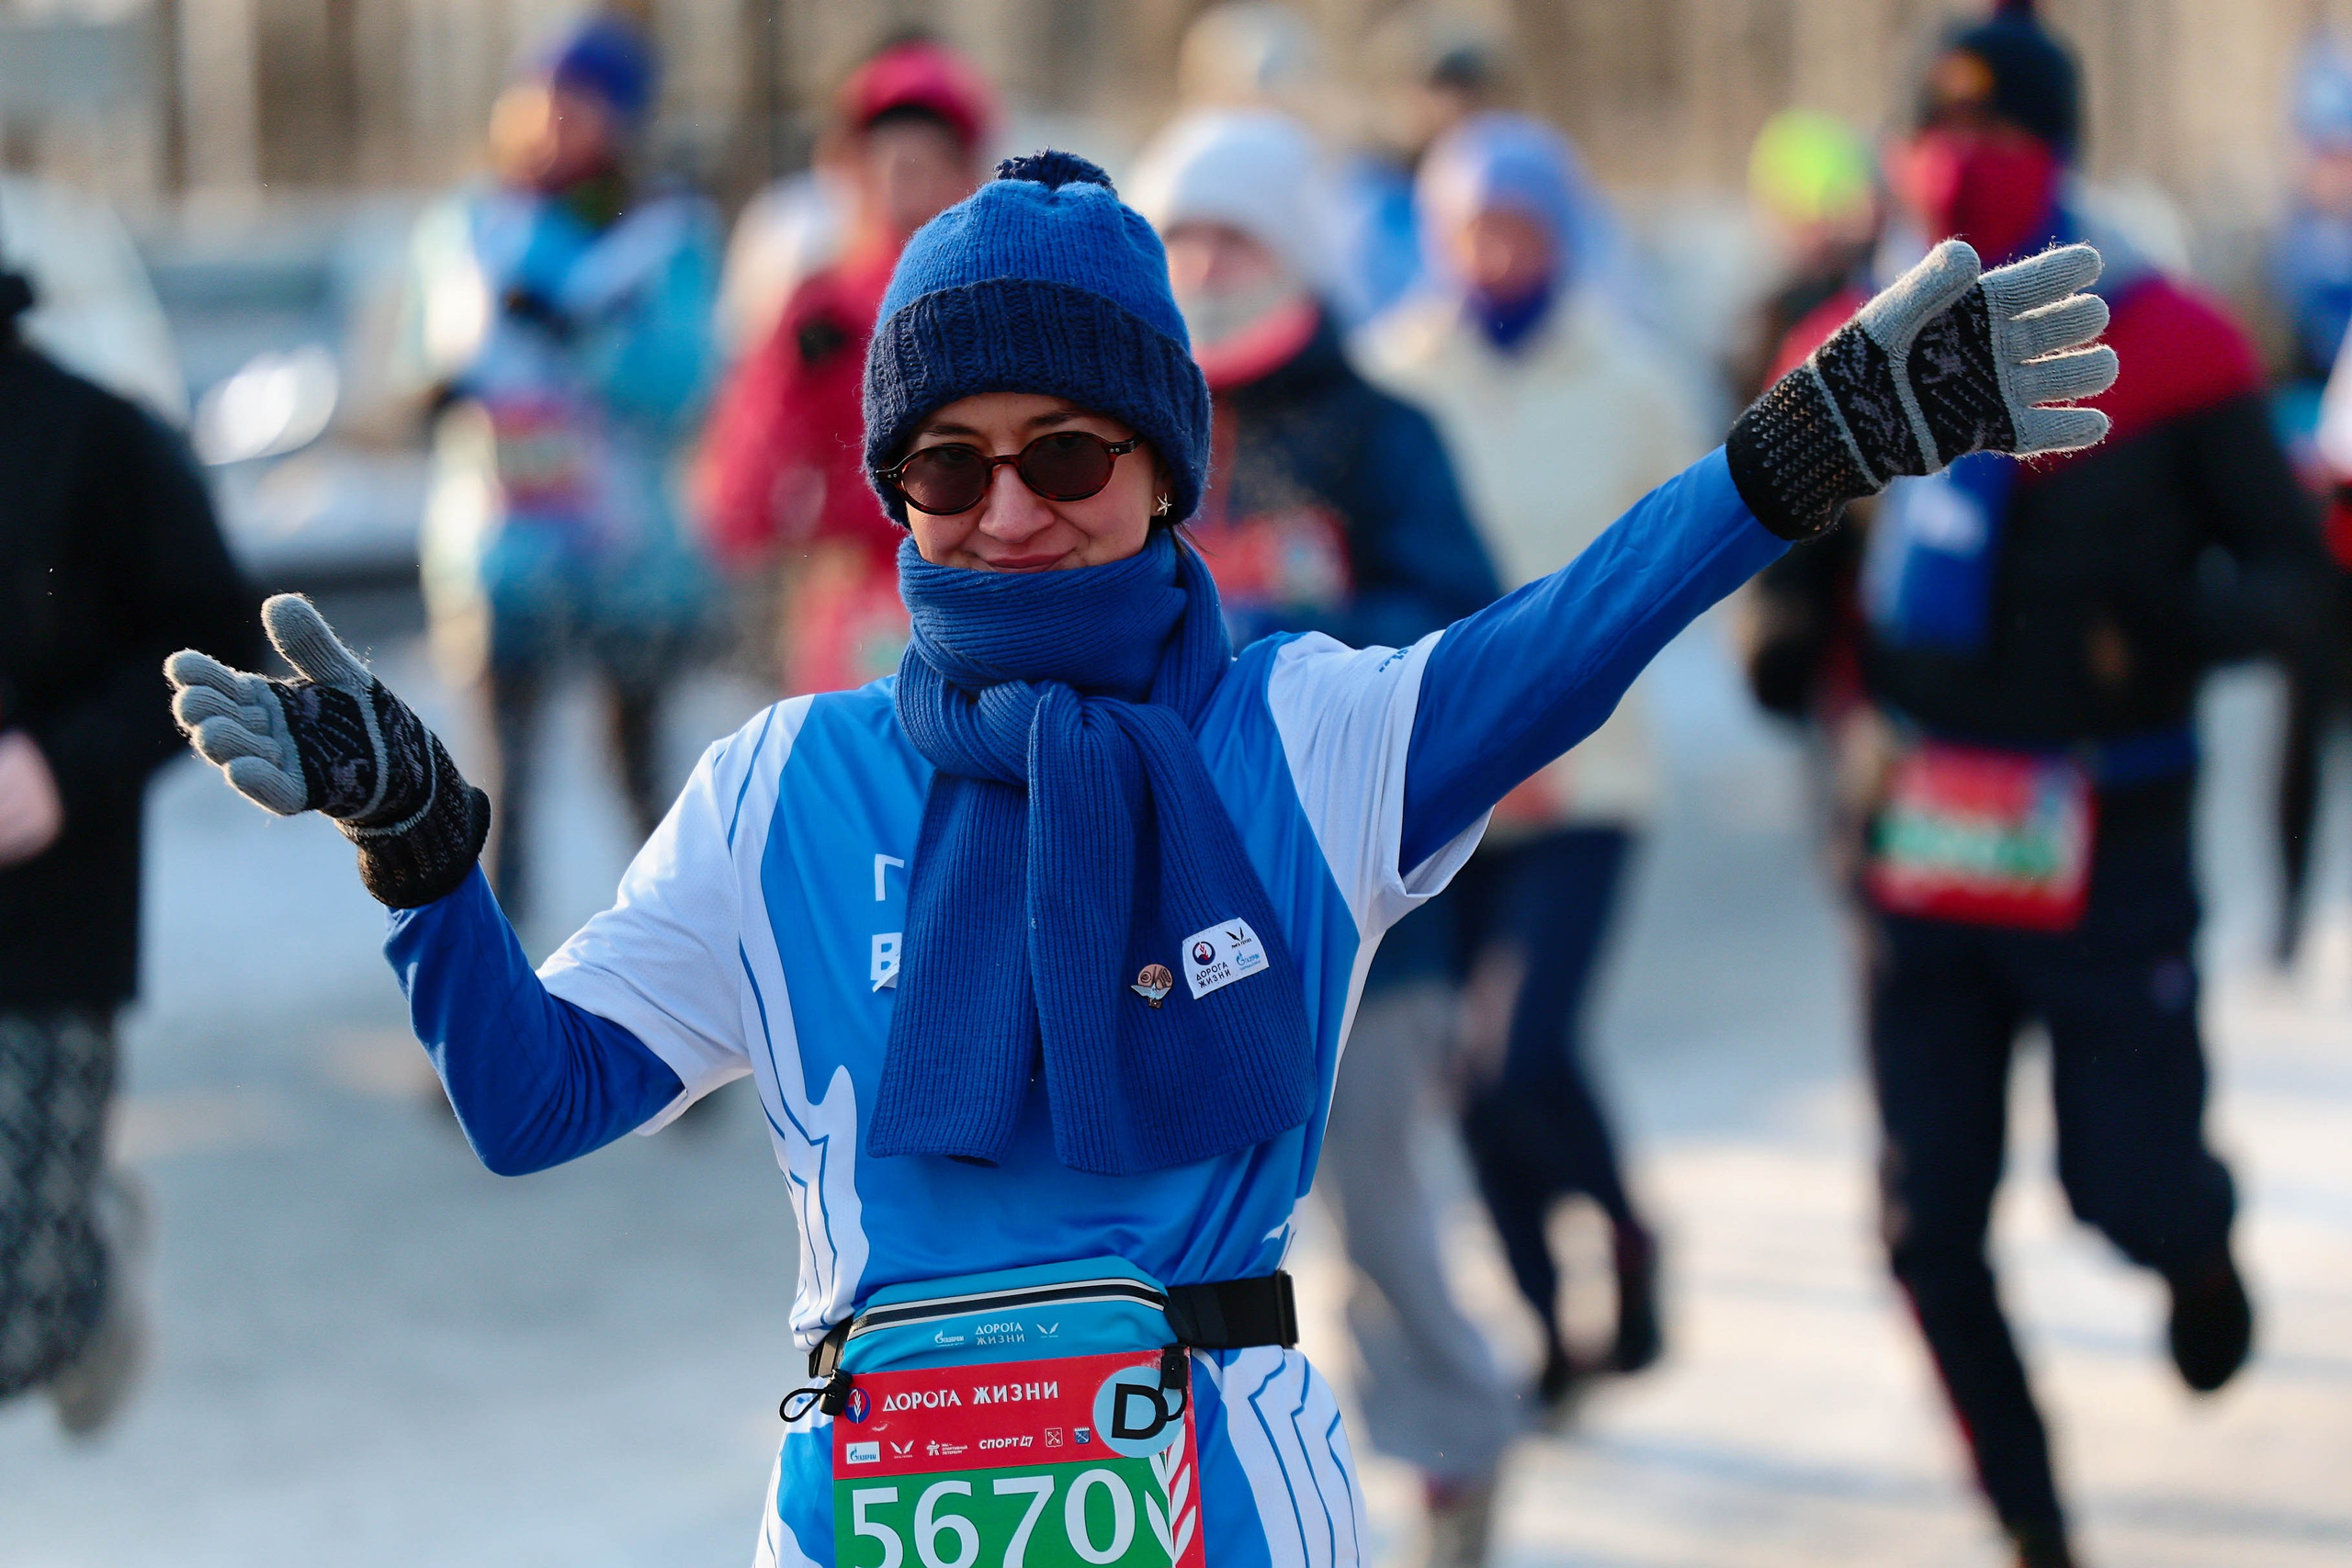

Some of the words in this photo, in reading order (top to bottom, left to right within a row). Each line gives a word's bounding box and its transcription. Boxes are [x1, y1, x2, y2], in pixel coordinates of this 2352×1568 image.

[1196, 962, 1228, 981] ДОРОГА
[1198, 968, 1231, 988] ЖИЗНИ
[975, 1322, 1023, 1336] ДОРОГА
[977, 1334, 1025, 1346] ЖИЗНИ
[882, 1389, 963, 1412] ДОРОГА
[973, 1382, 1059, 1404] ЖИЗНИ
[1111, 1382, 1169, 1440] D
[852, 1469, 1136, 1568] 5670
